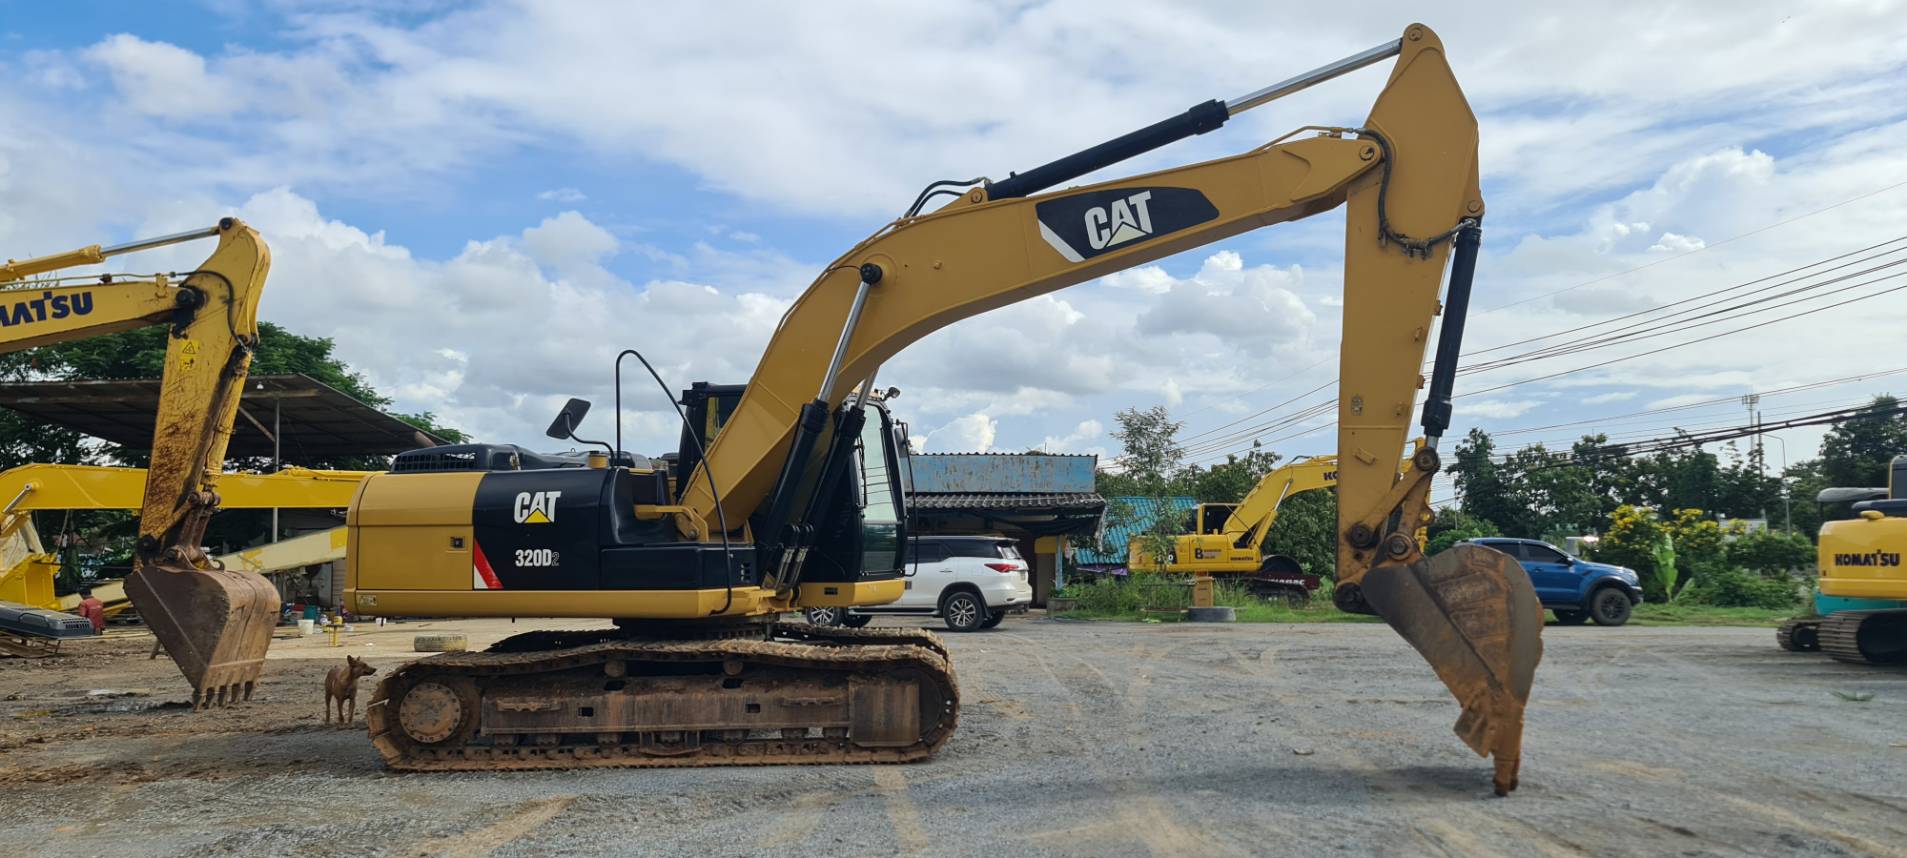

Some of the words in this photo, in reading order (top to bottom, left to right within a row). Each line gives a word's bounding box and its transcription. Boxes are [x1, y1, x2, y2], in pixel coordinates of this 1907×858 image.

[1084, 190, 1153, 250] CAT
[514, 491, 562, 523] CAT
[1834, 549, 1900, 567] KOMATSU
